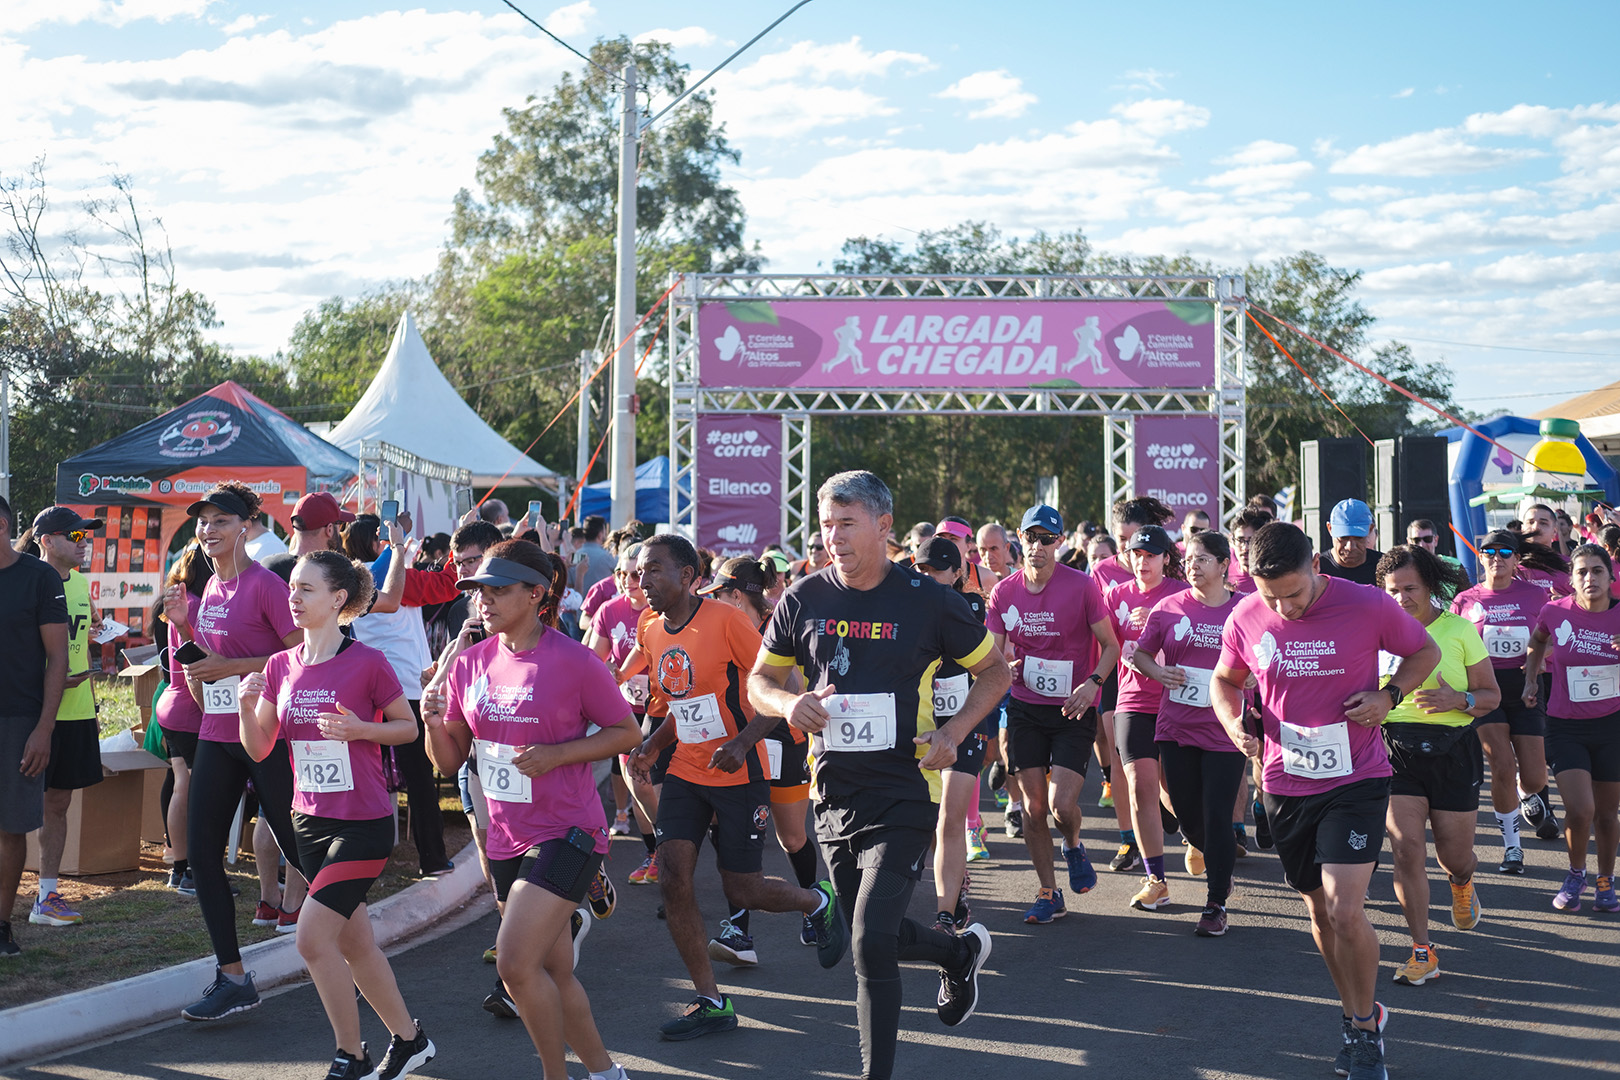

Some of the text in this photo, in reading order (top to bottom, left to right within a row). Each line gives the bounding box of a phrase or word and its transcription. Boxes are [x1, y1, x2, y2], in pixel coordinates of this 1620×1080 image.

[869, 315, 1043, 344] LARGADA
[749, 351, 779, 361] Altos
[877, 345, 1058, 375] CHEGADA
[1148, 351, 1179, 361] Altos
[706, 430, 743, 445] #eu
[714, 445, 772, 457] correr
[1146, 443, 1181, 458] #eu
[1153, 457, 1208, 470] correr
[709, 478, 772, 495] Ellenco
[825, 618, 893, 639] CORRER
[1025, 625, 1047, 633] Altos
[1195, 634, 1219, 644] Altos
[1293, 640, 1327, 649] Corrida
[1578, 640, 1601, 651] Altos
[1285, 647, 1336, 656] Caminhada
[1491, 640, 1521, 653] 193
[1286, 659, 1319, 670] Altos
[1299, 668, 1345, 677] Primavera
[1036, 676, 1057, 692] 83
[1588, 682, 1600, 696] 6
[206, 689, 232, 707] 153
[302, 689, 328, 698] Corrida
[1179, 684, 1199, 701] 72
[294, 696, 335, 704] Caminhada
[934, 695, 957, 711] 90
[293, 707, 318, 718] Altos
[489, 703, 516, 715] Altos
[680, 703, 703, 723] 24
[488, 714, 539, 723] da Primavera
[841, 721, 874, 744] 94
[1291, 748, 1338, 771] 203
[304, 763, 341, 784] 182
[487, 765, 510, 790] 78
